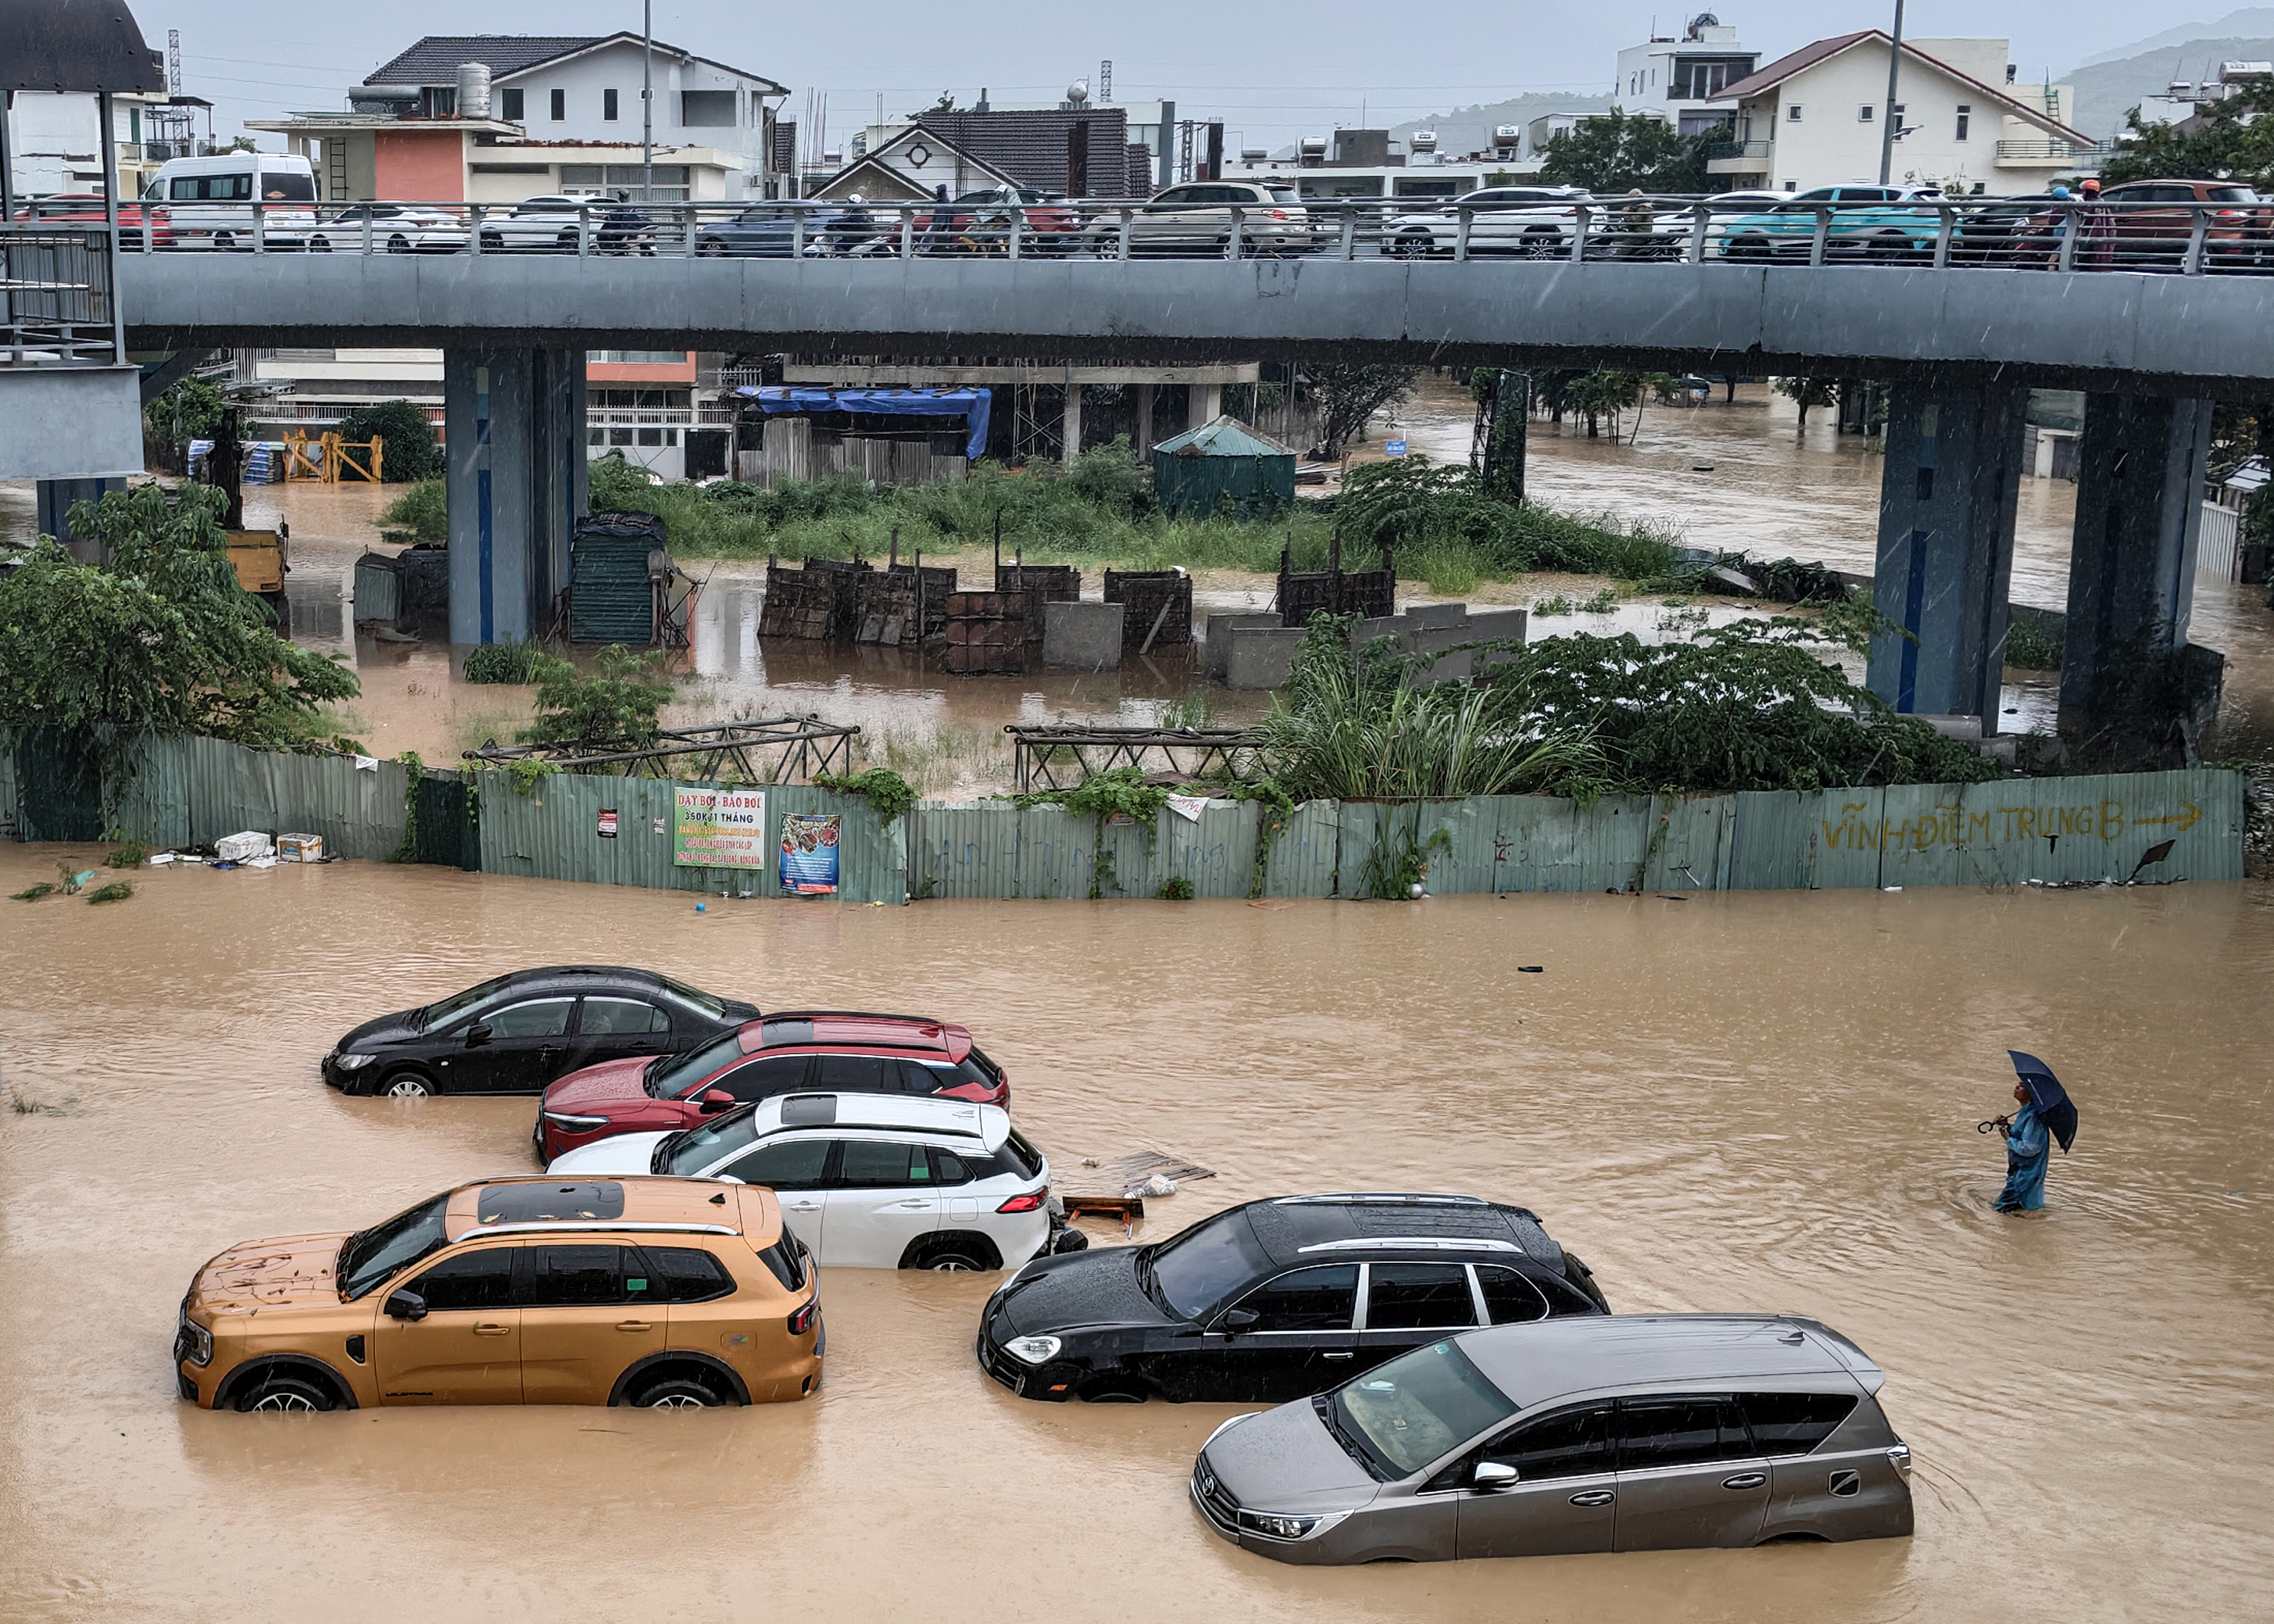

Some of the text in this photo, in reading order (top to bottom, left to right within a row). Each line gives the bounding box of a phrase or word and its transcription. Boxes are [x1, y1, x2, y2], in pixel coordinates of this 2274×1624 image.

[720, 811, 754, 824] THÁNG
[1822, 801, 1909, 850] VĨNH
[1997, 806, 2094, 843] TRUNG
